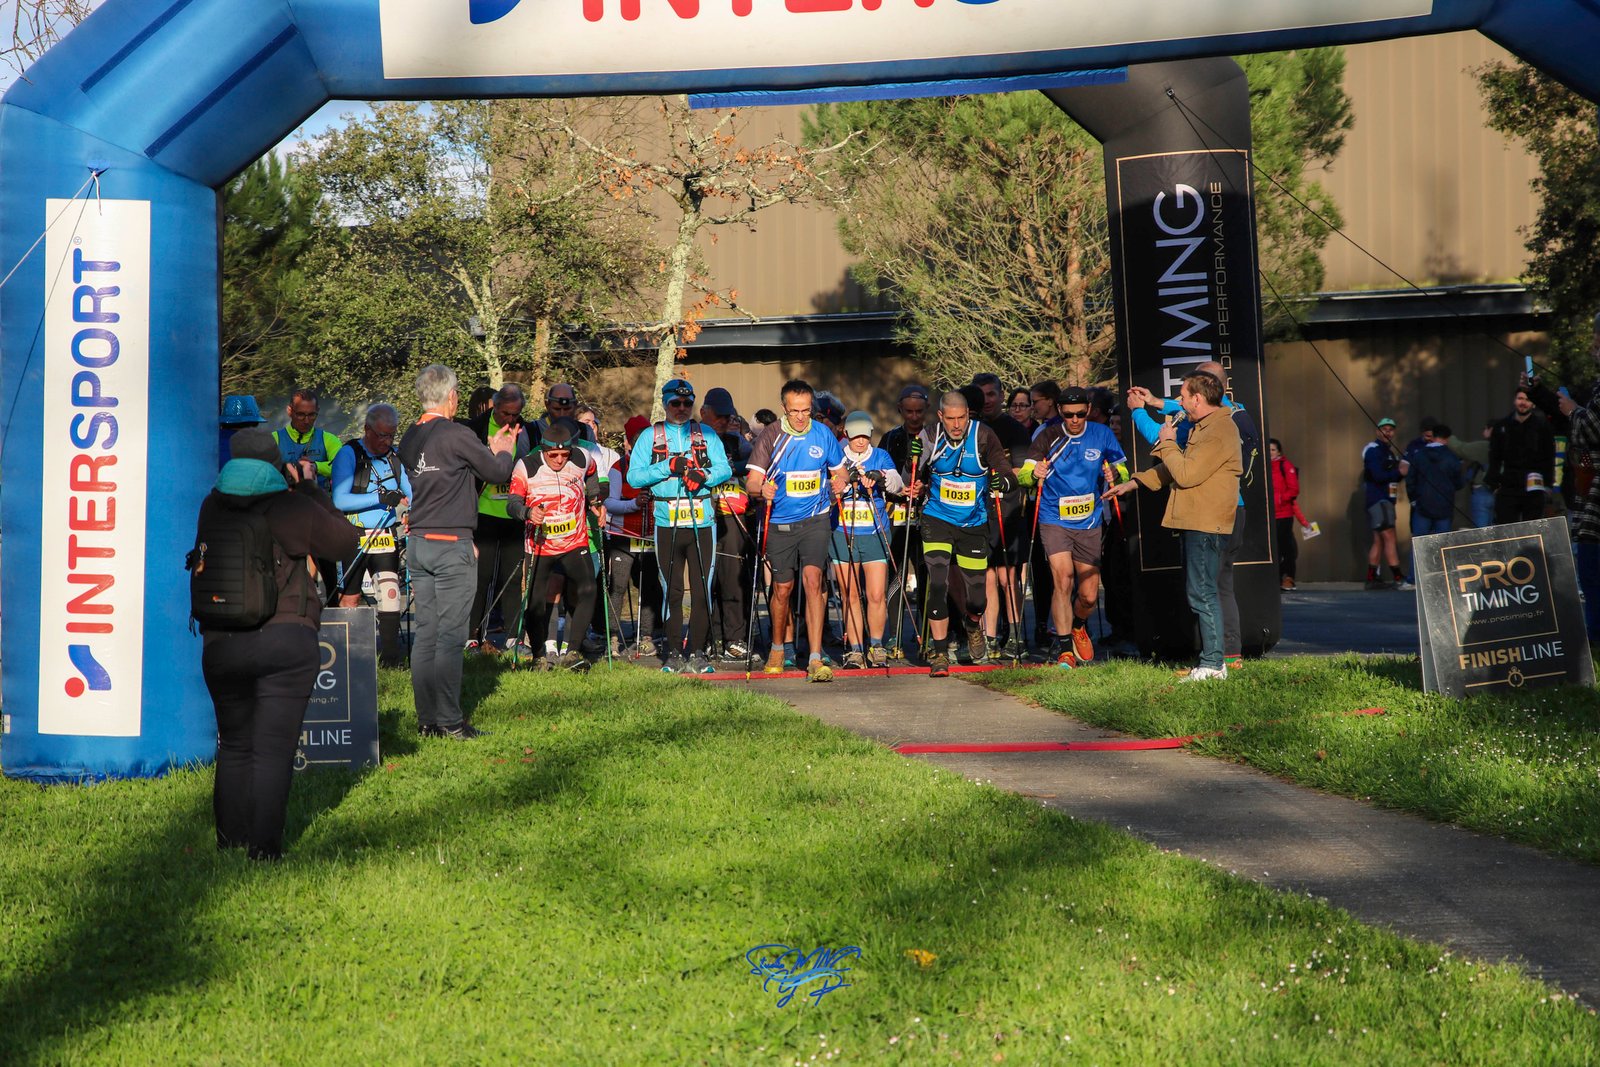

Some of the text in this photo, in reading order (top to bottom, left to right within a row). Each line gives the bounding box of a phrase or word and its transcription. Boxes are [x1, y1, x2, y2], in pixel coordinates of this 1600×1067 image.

[1210, 181, 1230, 336] PERFORMANCE
[1153, 184, 1212, 397] TIMING
[1220, 343, 1232, 370] DE
[65, 247, 121, 634] INTERSPORT
[792, 480, 816, 491] 1036
[945, 489, 970, 500] 1033
[1065, 503, 1090, 515] 1035
[547, 522, 571, 534] 1001
[1456, 556, 1536, 593] PRO
[1461, 584, 1540, 611] TIMING
[1465, 610, 1545, 626] www.protiming.fr
[1458, 640, 1565, 670] FINISHLINE
